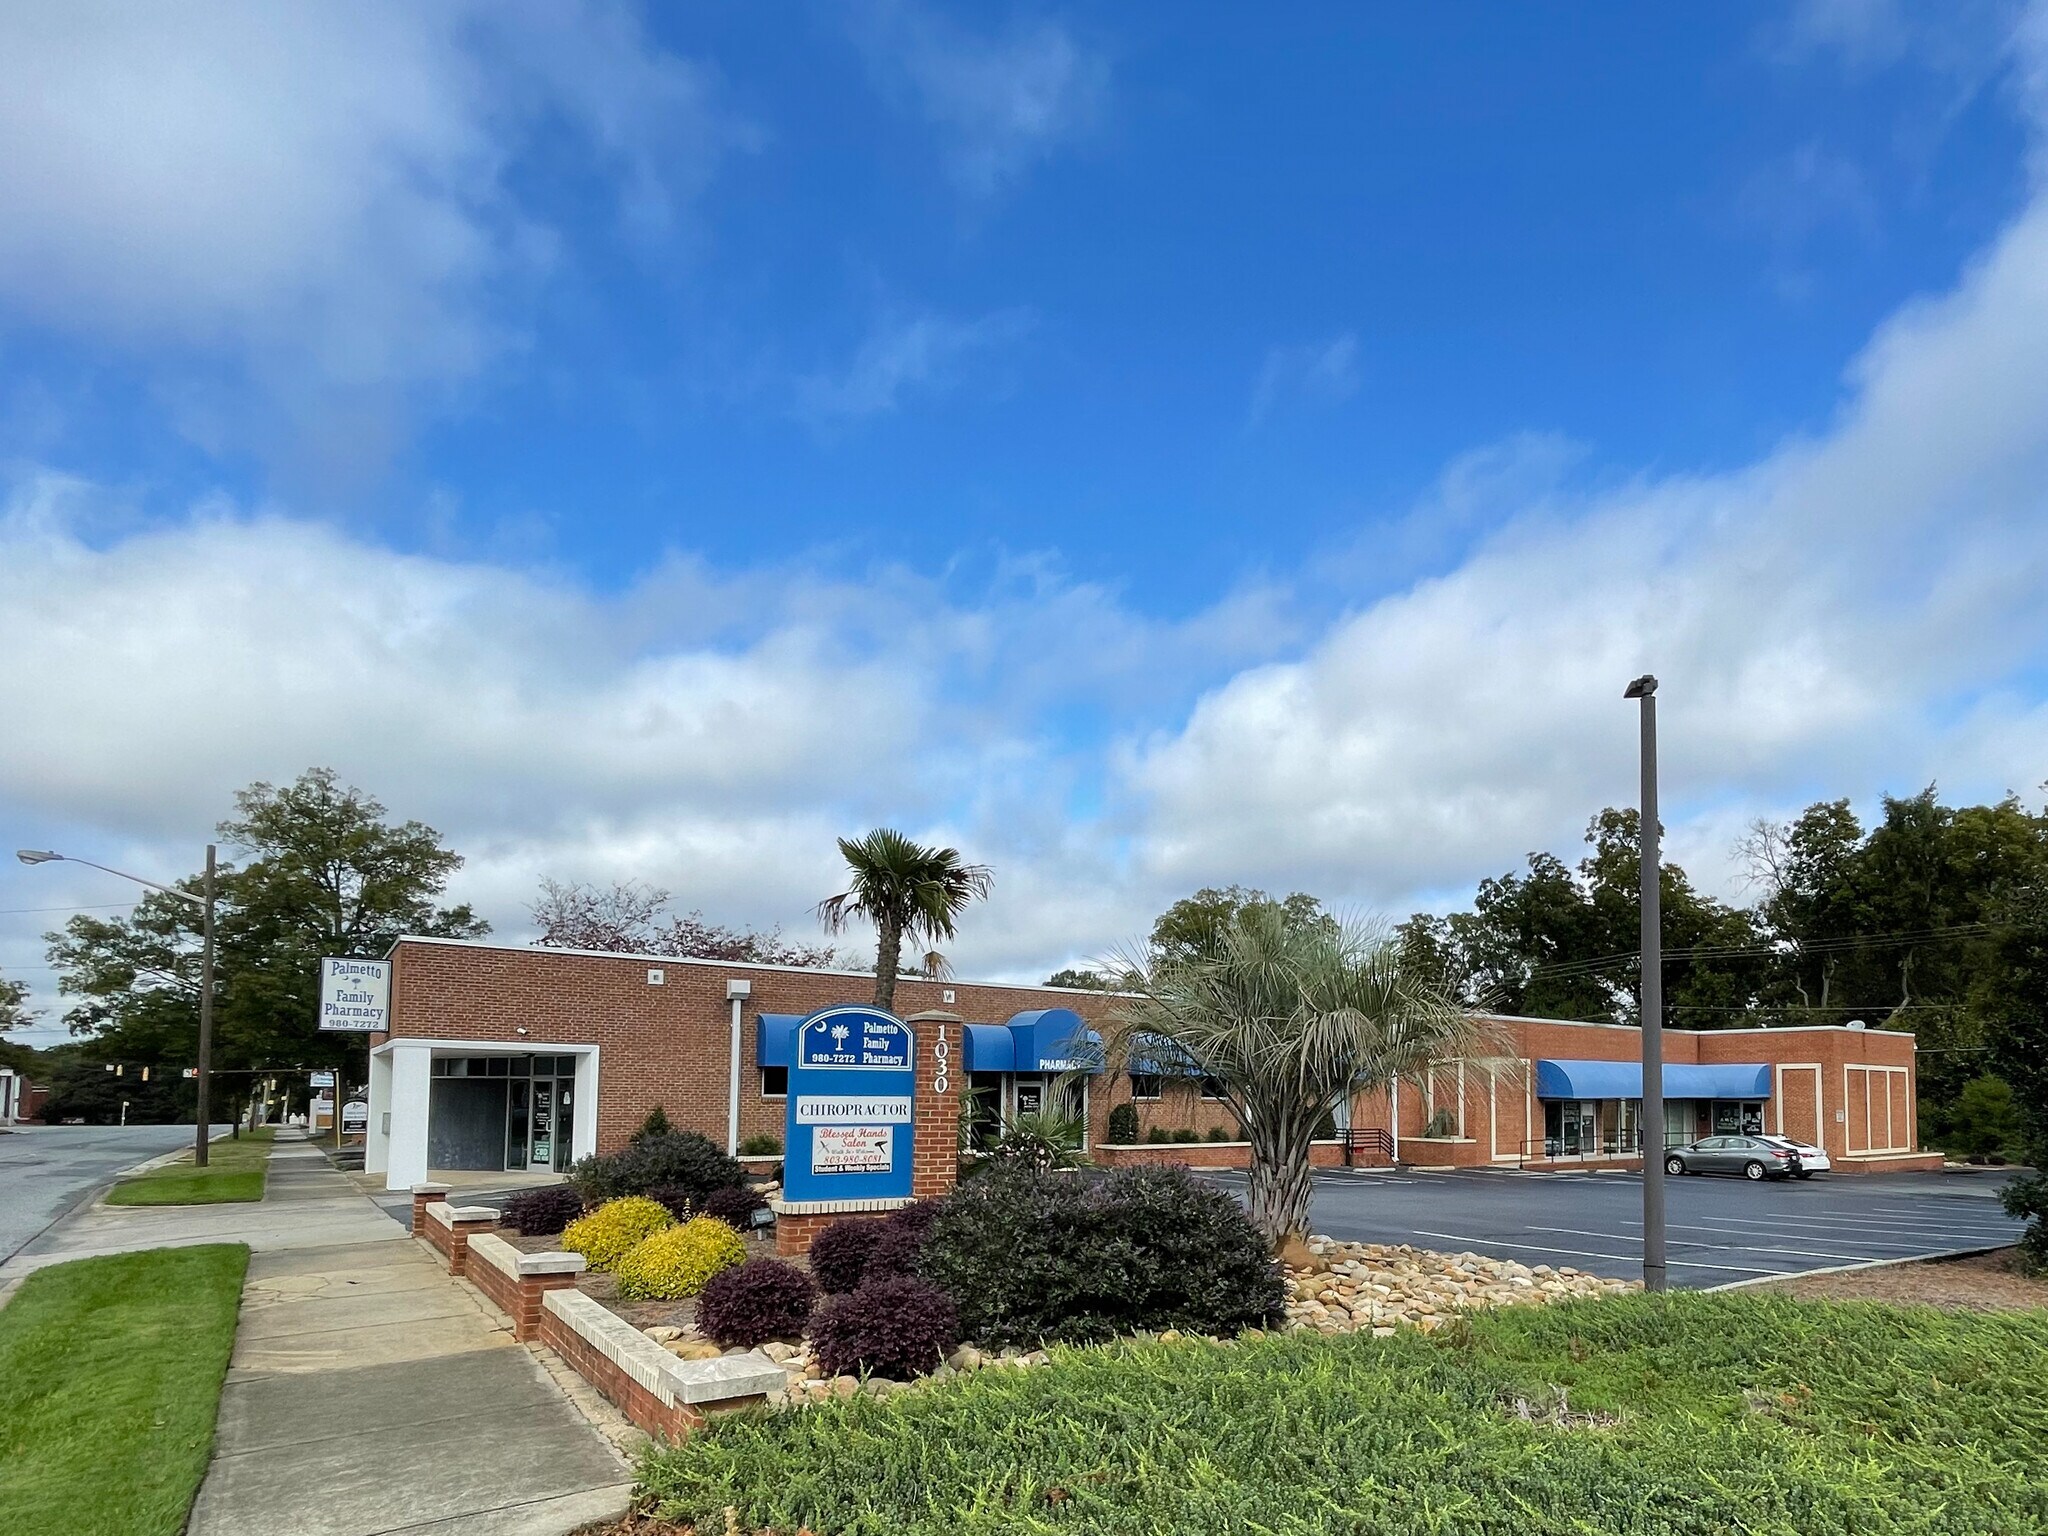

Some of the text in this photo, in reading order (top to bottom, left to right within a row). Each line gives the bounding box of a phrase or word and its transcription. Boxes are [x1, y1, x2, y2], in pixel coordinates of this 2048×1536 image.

[331, 961, 381, 979] Palmetto
[336, 989, 374, 1005] Family
[325, 1003, 384, 1020] Pharmacy
[329, 1020, 379, 1028] 980-7272
[863, 1022, 898, 1035] Palmetto
[863, 1037, 890, 1051] Family
[812, 1053, 856, 1063] 980-7272
[863, 1052, 903, 1066] Pharmacy
[934, 1024, 949, 1093] 1030
[800, 1103, 907, 1116] CHIROPRACTOR
[820, 1128, 887, 1139] Blessed Hands
[841, 1138, 867, 1148] Salon
[535, 1148, 548, 1156] CBD
[824, 1155, 882, 1164] 803-980-8081
[814, 1165, 838, 1173] Student
[866, 1164, 890, 1172] Specials
